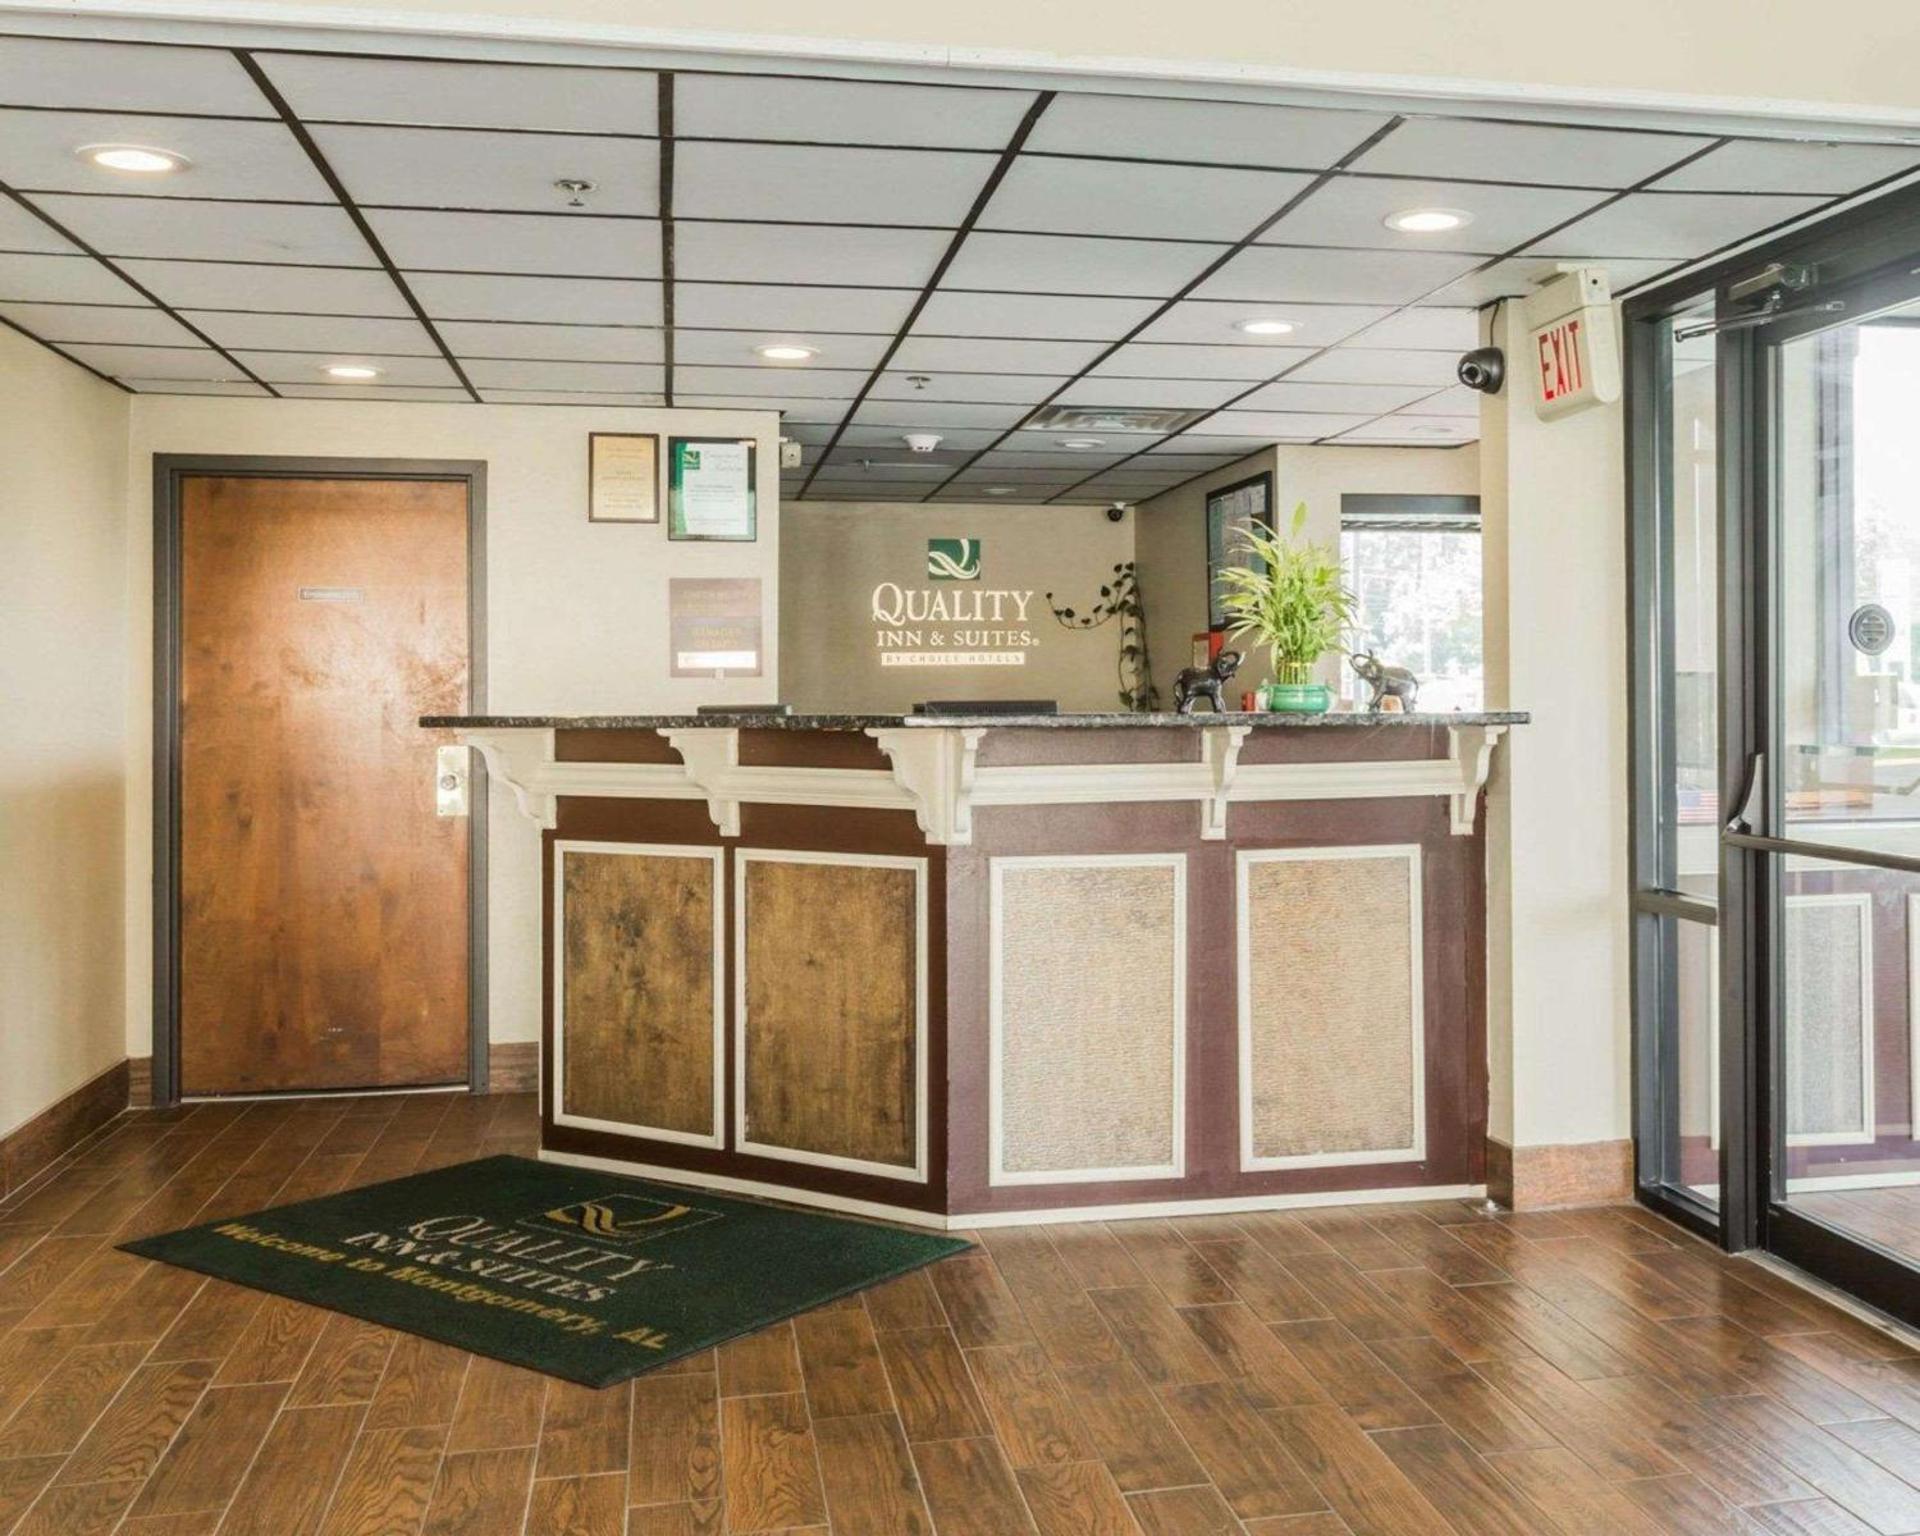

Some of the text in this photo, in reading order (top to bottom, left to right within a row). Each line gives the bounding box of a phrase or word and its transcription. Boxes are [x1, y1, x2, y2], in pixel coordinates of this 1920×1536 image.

[1539, 320, 1582, 400] EXIT
[872, 582, 1034, 626] QUALITY
[876, 631, 922, 646] INN
[930, 631, 944, 646] &
[342, 1231, 433, 1256] INN
[450, 1256, 617, 1302] SUITES
[404, 1215, 675, 1281] QUALITY
[212, 1223, 346, 1262] Welcome
[346, 1258, 387, 1272] to
[612, 1326, 669, 1350] AL
